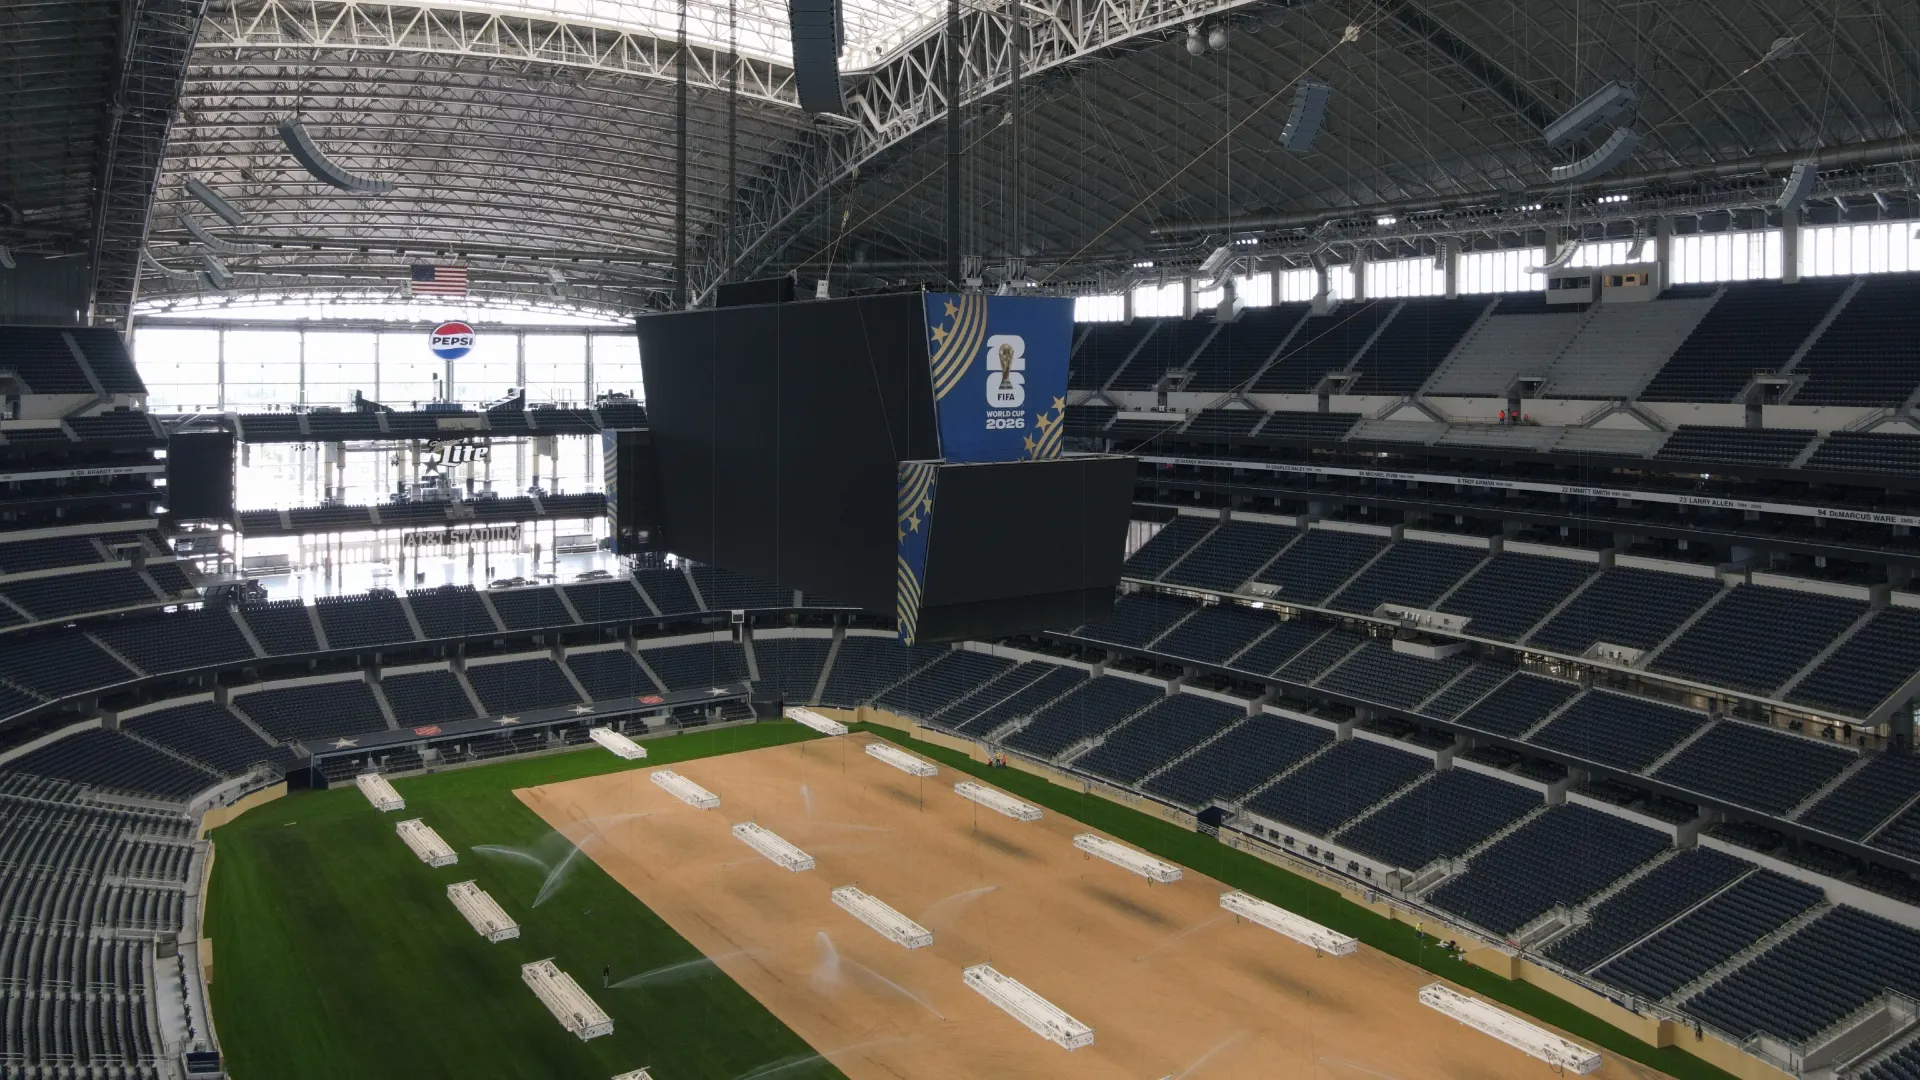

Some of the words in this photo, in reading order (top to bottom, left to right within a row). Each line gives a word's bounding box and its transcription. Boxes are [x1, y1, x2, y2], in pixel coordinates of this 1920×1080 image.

[432, 337, 473, 346] PEPSI
[997, 393, 1015, 401] FIFA
[986, 418, 1025, 430] 2026
[439, 445, 489, 467] Lite
[1873, 514, 1897, 523] WARE
[406, 530, 447, 547] AT&T
[450, 526, 521, 544] STADIUM
